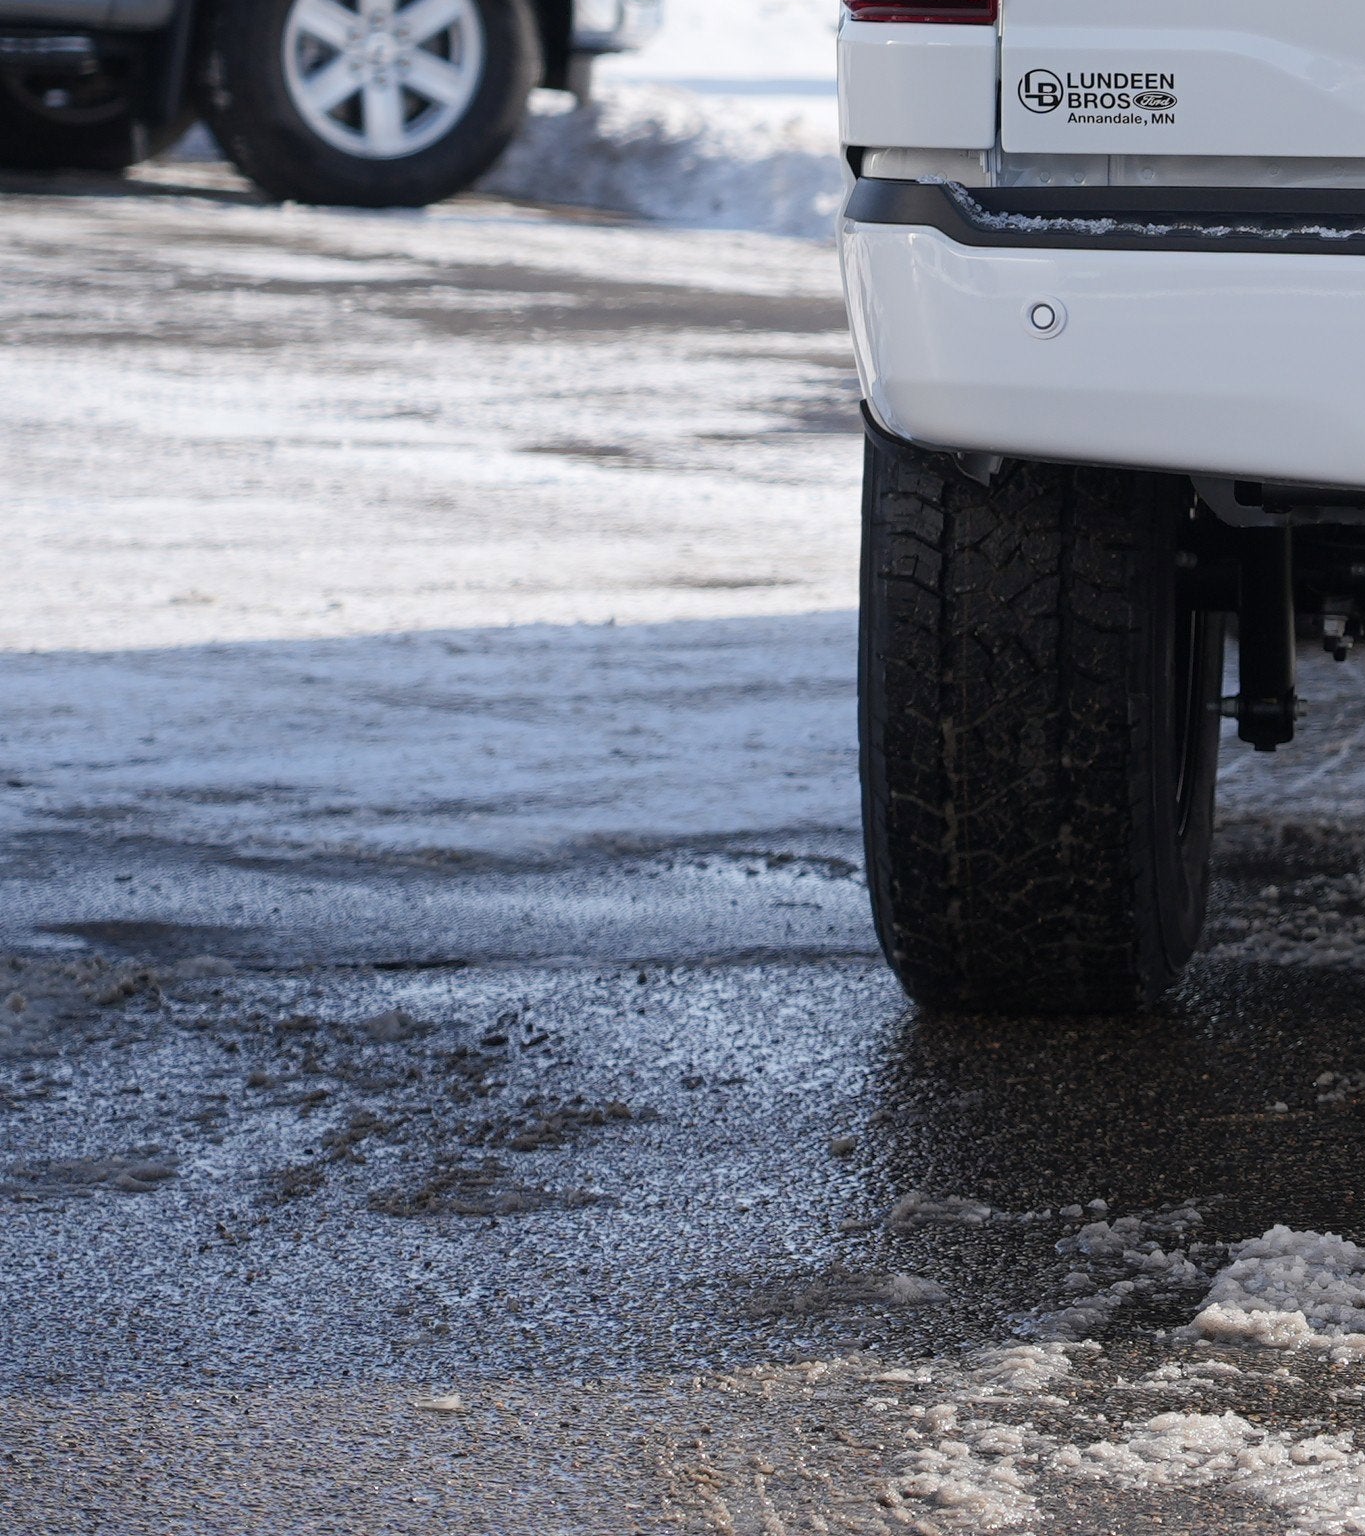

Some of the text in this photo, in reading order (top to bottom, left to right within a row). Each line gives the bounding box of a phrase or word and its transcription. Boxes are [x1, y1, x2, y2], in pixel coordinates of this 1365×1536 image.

[1066, 72, 1175, 90] LUNDEEN
[1067, 92, 1131, 109] BROS
[1067, 113, 1175, 126] Annandale, MN
